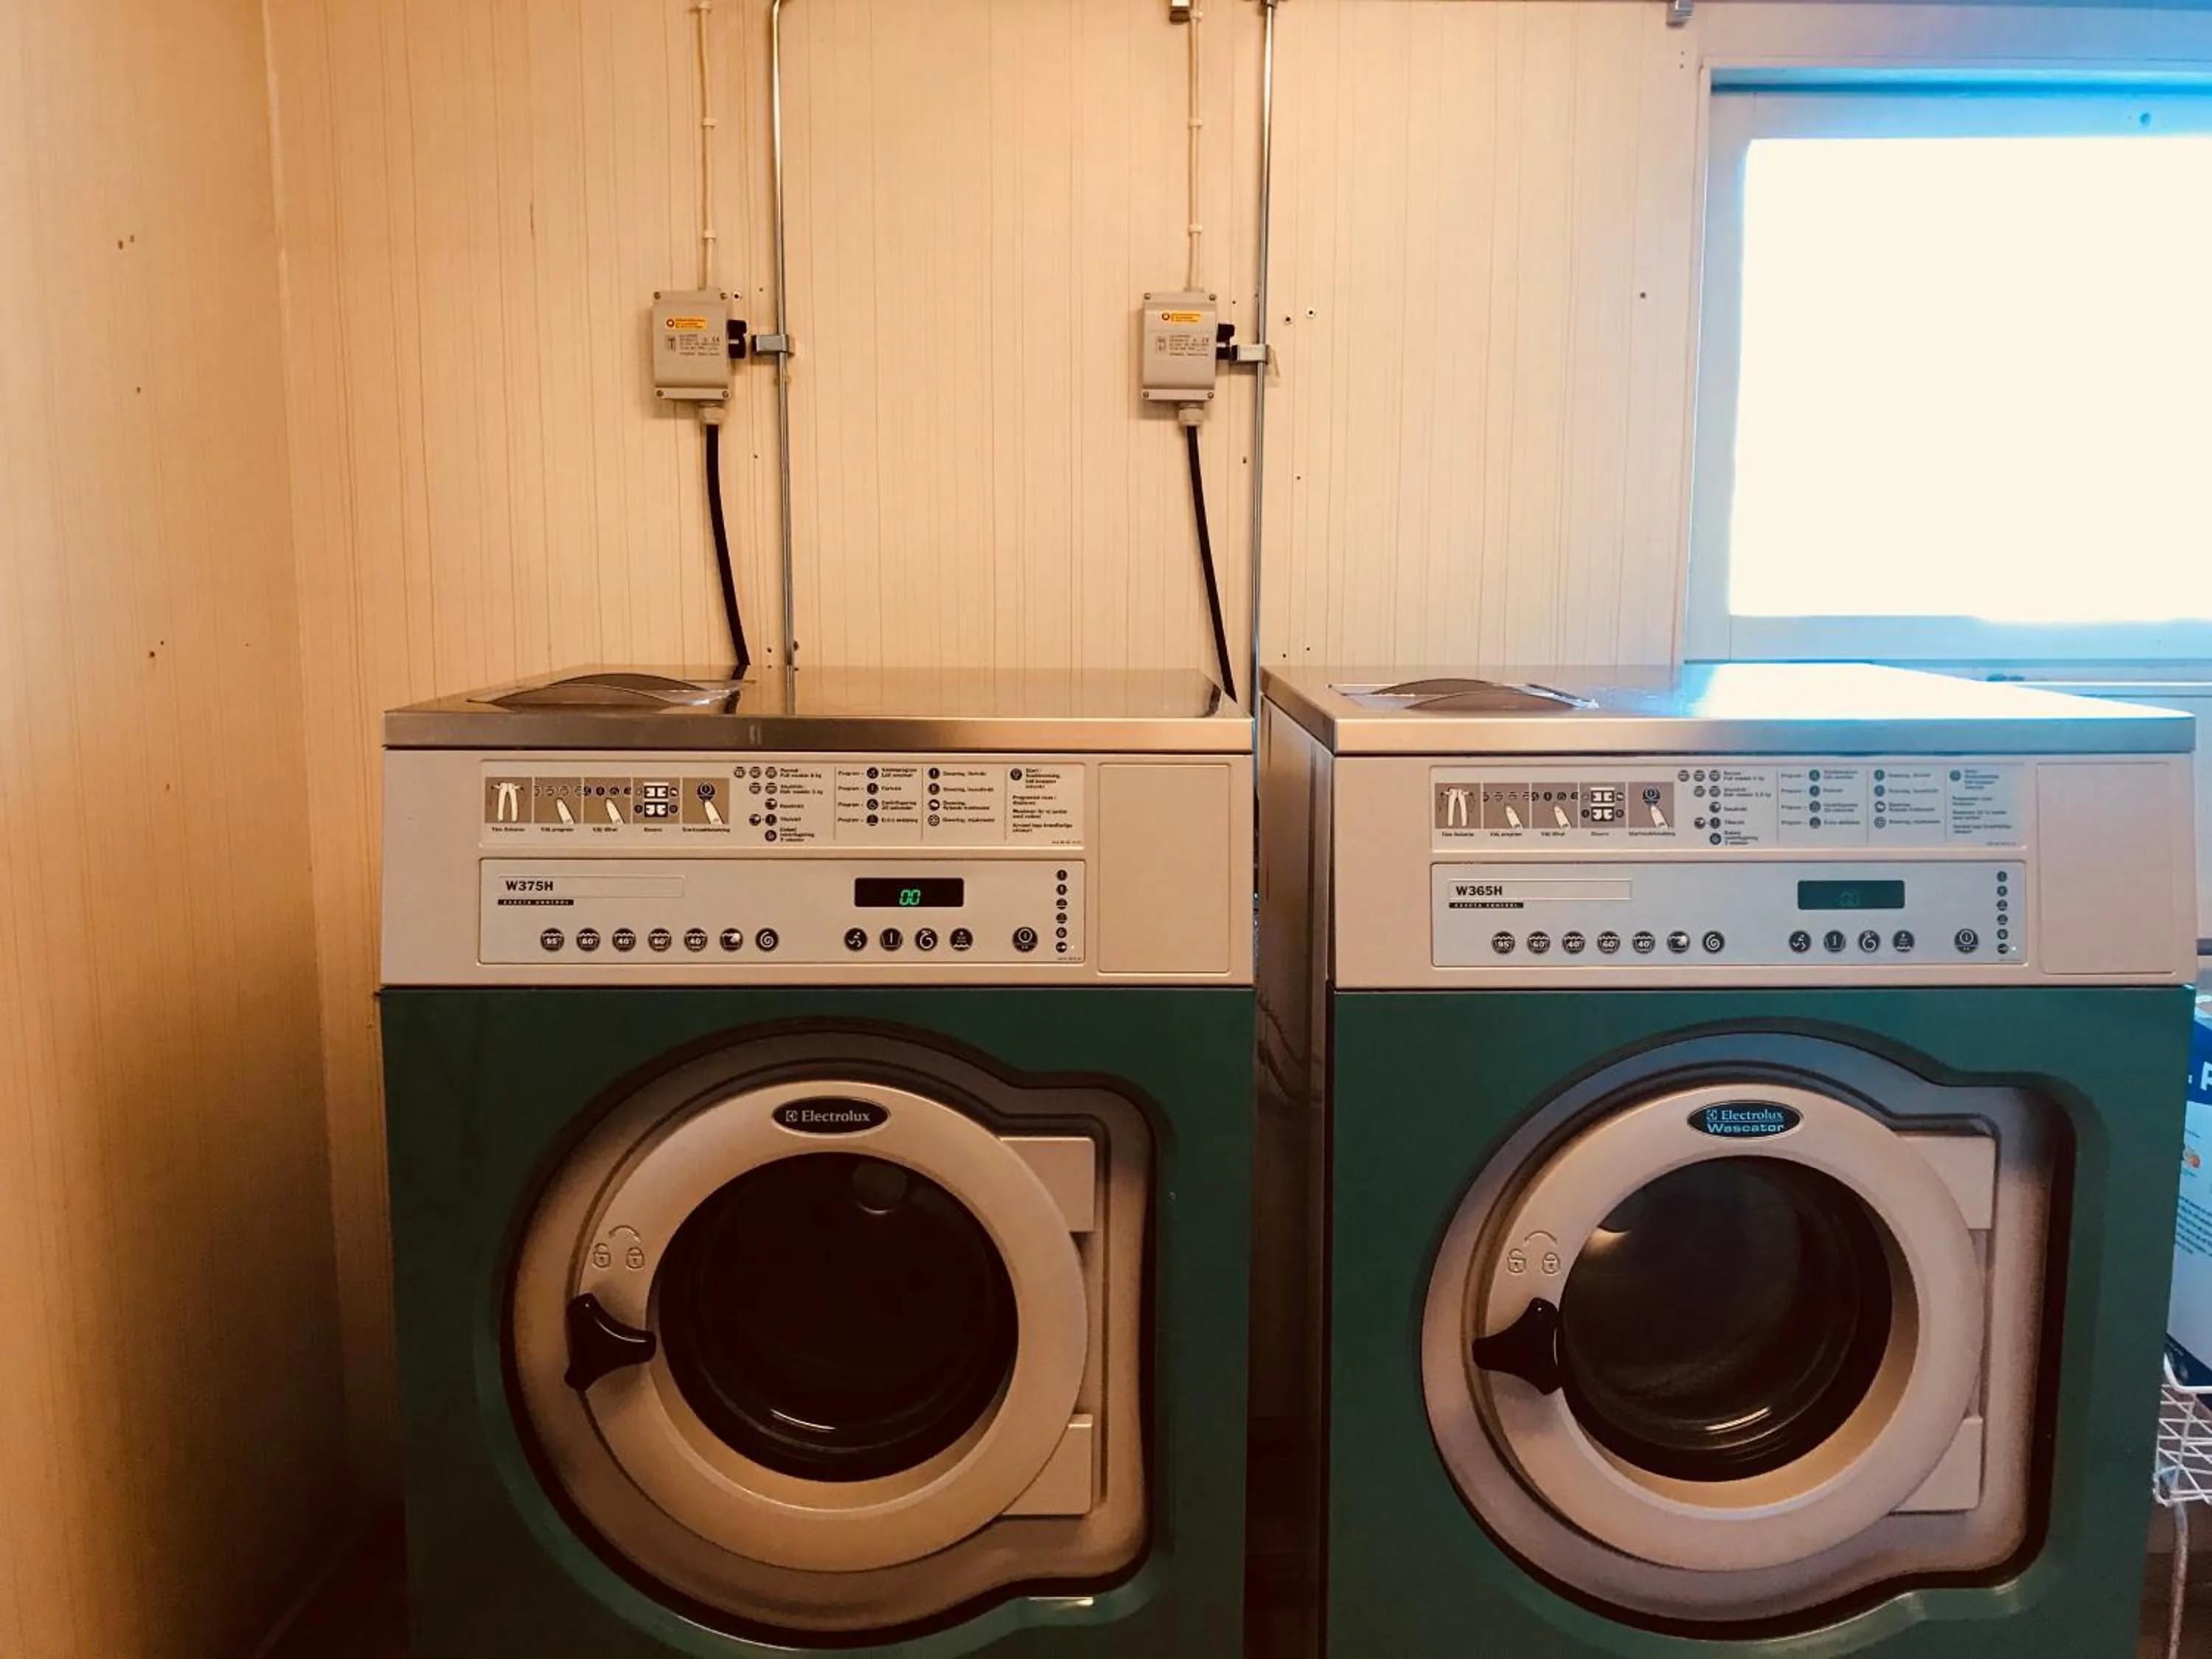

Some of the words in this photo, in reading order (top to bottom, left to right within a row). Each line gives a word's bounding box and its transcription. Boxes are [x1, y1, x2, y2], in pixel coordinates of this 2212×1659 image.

[505, 880, 554, 891] W375H
[1455, 886, 1503, 896] W365H
[899, 888, 921, 906] 00
[801, 1110, 871, 1122] Electrolux
[1721, 1109, 1783, 1120] Electrolux
[1707, 1123, 1784, 1133] Wascator
